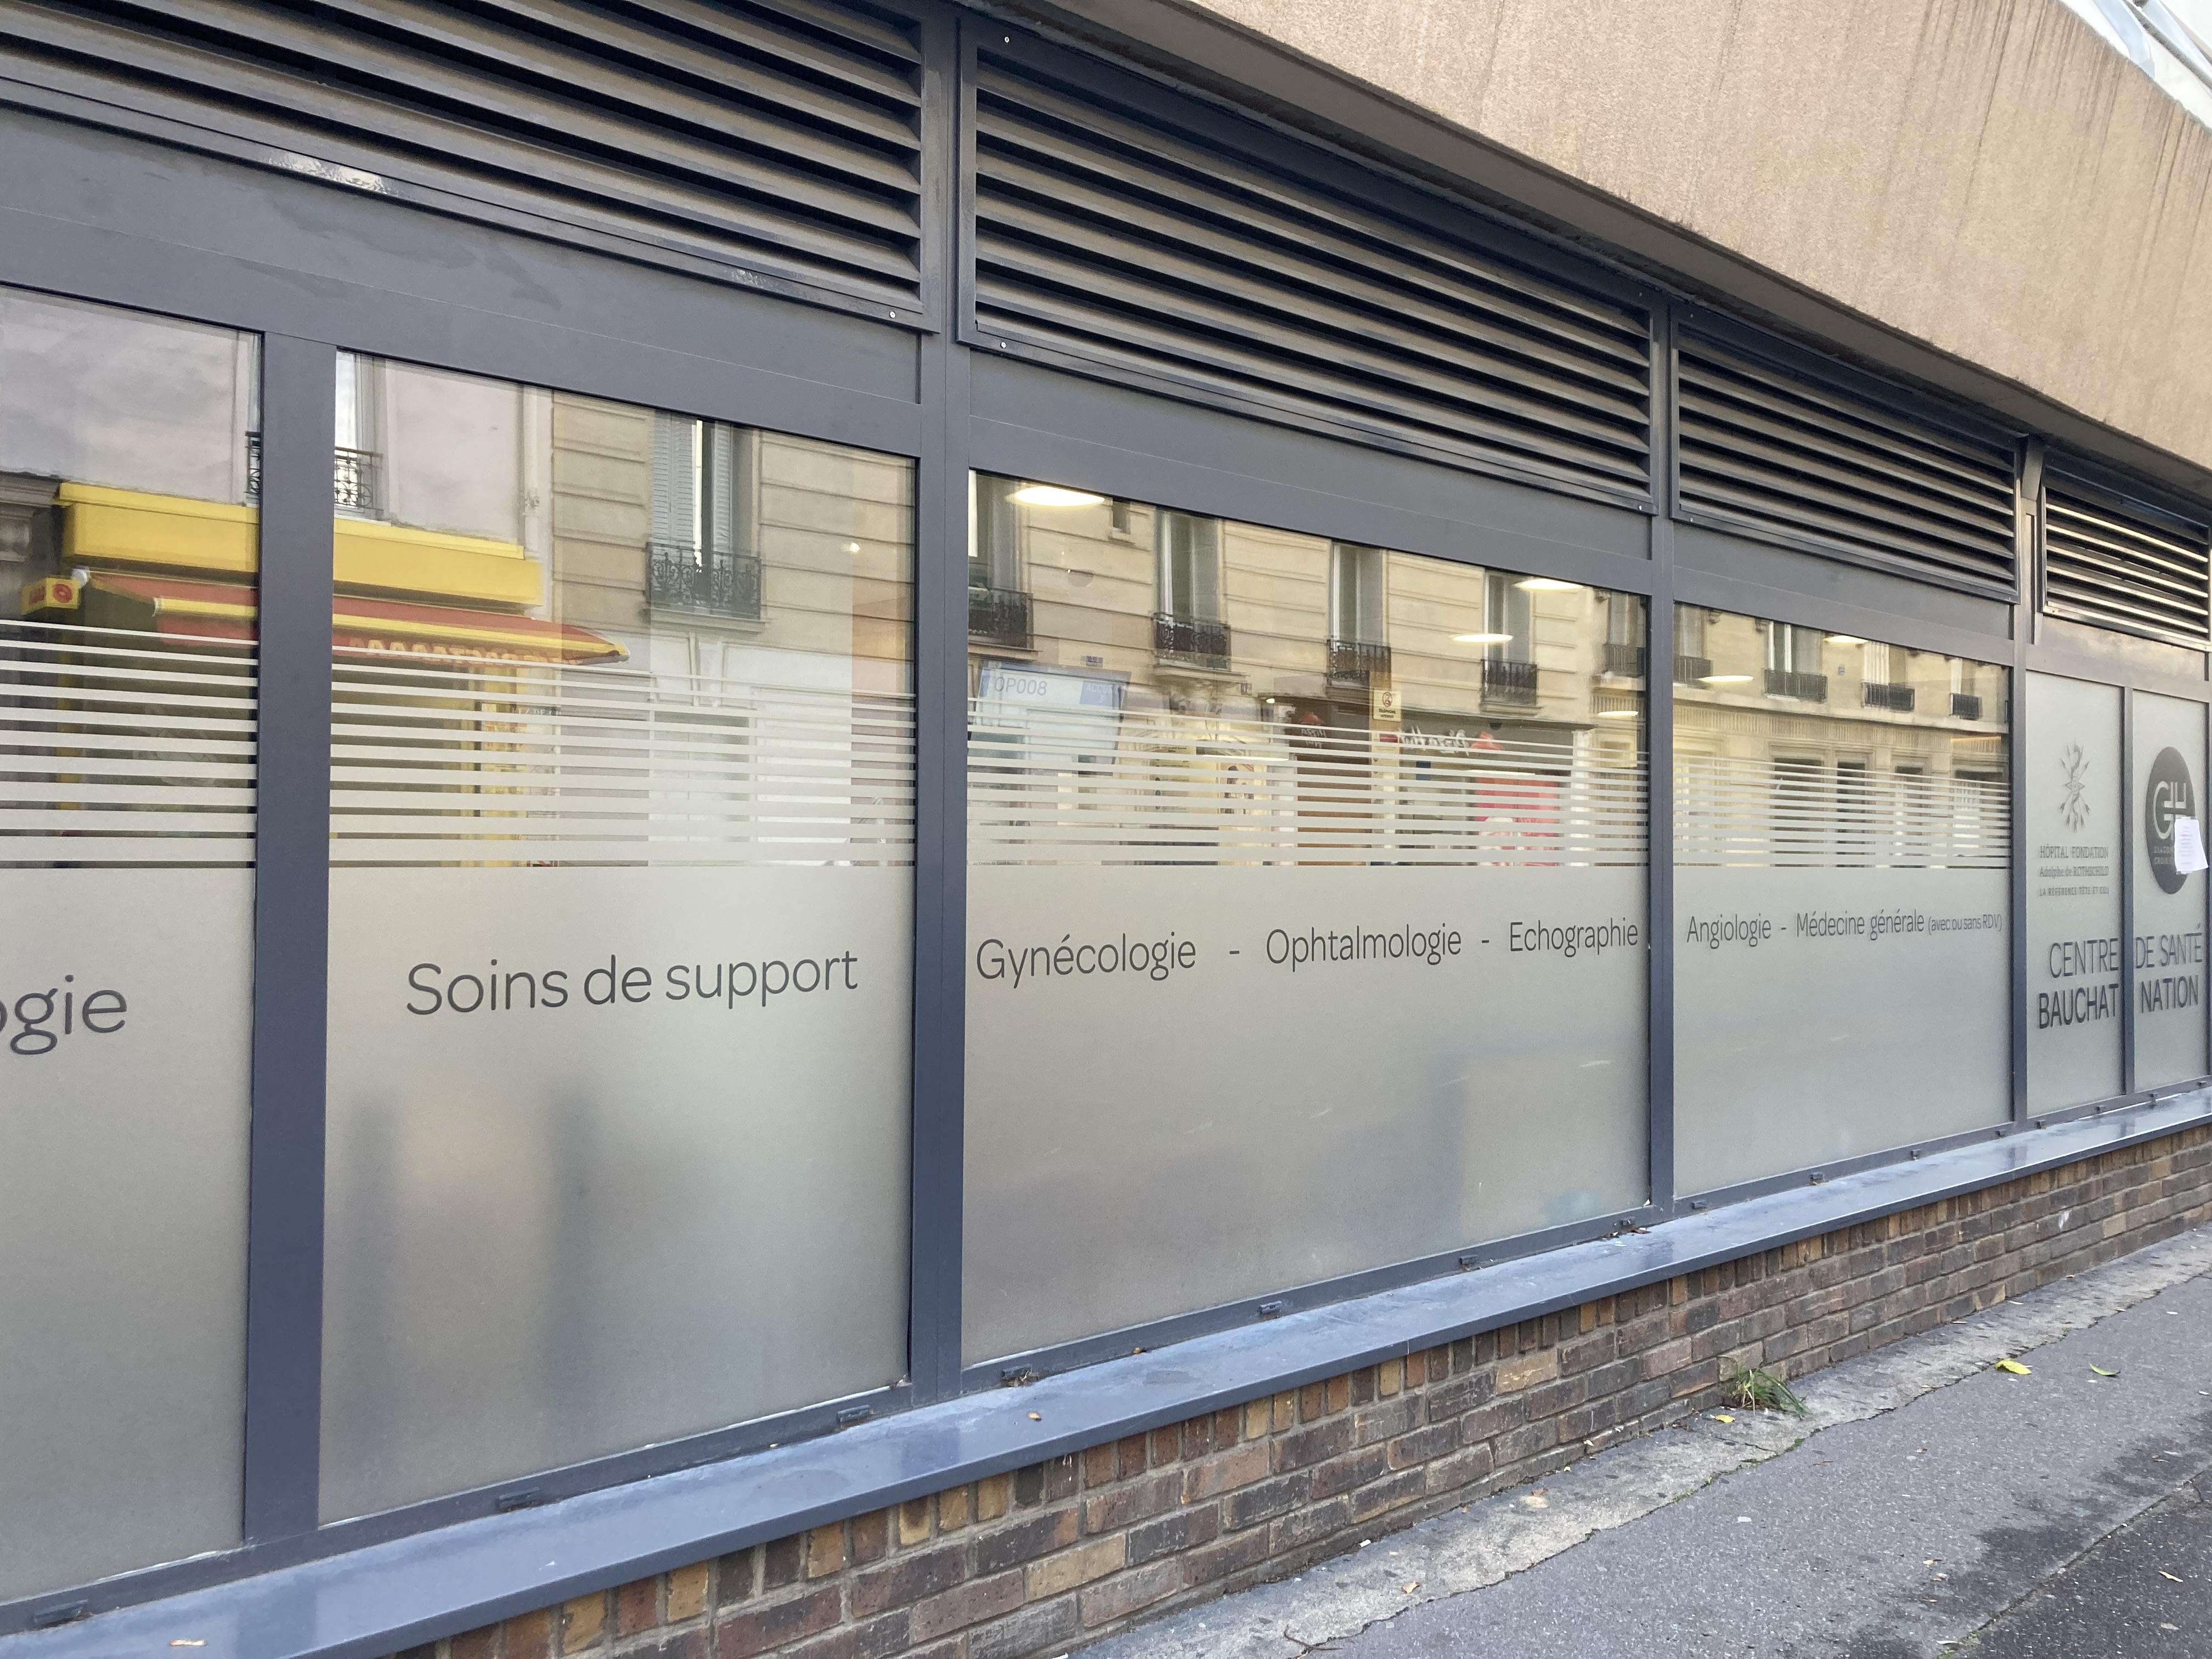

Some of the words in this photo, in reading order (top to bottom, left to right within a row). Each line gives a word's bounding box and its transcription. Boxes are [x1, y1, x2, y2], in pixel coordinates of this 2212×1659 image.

[994, 676, 1047, 696] OP008
[2040, 843, 2069, 859] HÔPITAL
[2072, 846, 2109, 859] FONDATION
[977, 931, 1196, 989] Gynécologie
[1266, 922, 1462, 973] Ophtalmologie
[1510, 917, 1638, 958] Echographie
[1687, 913, 1771, 950] Angiologie
[1797, 909, 1865, 938] Médecine
[1870, 908, 1925, 941] générale
[1928, 916, 1950, 936] (avec
[1952, 918, 1963, 930] ou
[1963, 918, 1982, 930] sans
[1982, 913, 2002, 932] RDV)
[2049, 938, 2119, 979] CENTRE
[2135, 935, 2155, 969] DE
[2160, 923, 2203, 967] SANTÉ
[407, 958, 568, 1015] Soins
[584, 954, 652, 1006] de
[665, 950, 858, 1010] support
[2039, 983, 2119, 1030] BAUCHAT
[2140, 975, 2198, 1014] NATION
[0, 974, 127, 1056] gie
